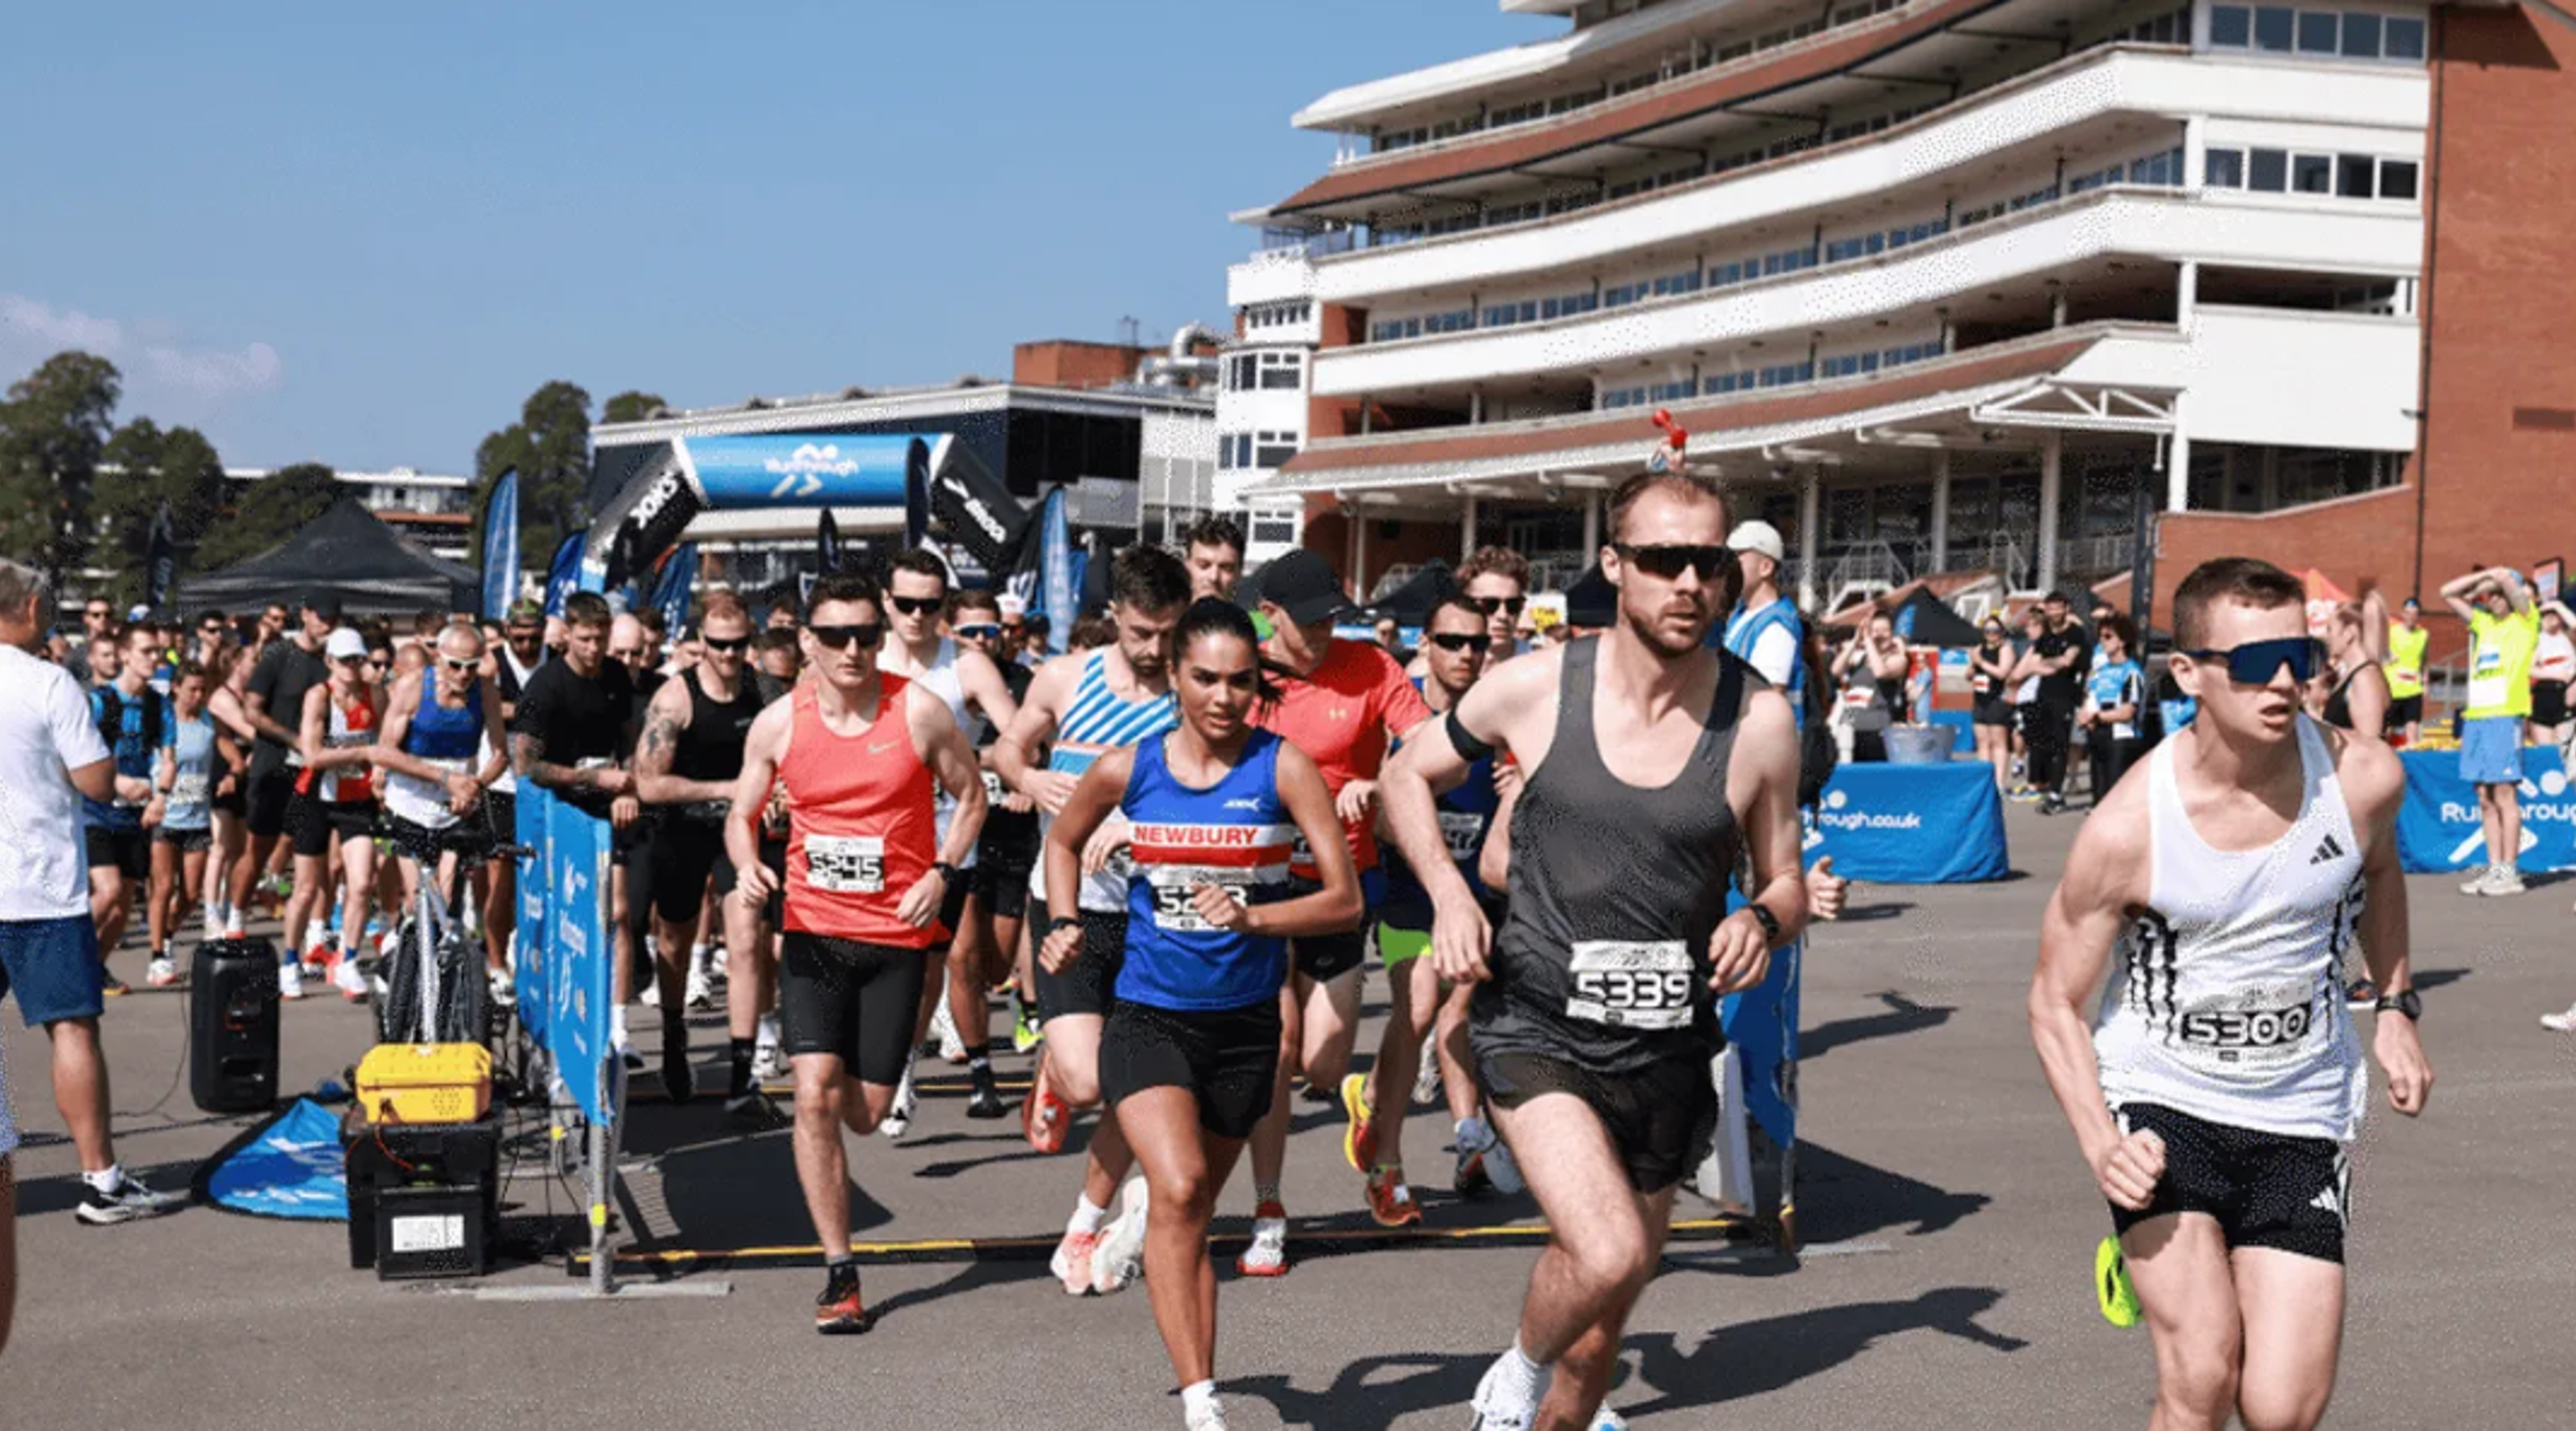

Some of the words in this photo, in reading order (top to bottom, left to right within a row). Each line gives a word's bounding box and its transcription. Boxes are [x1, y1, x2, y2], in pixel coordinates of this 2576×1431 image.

[1134, 826, 1258, 844] NEWBURY
[809, 853, 881, 880] 5245
[1157, 885, 1248, 914] 523
[1577, 971, 1690, 1008] 5339
[2188, 1006, 2307, 1045] 5300
